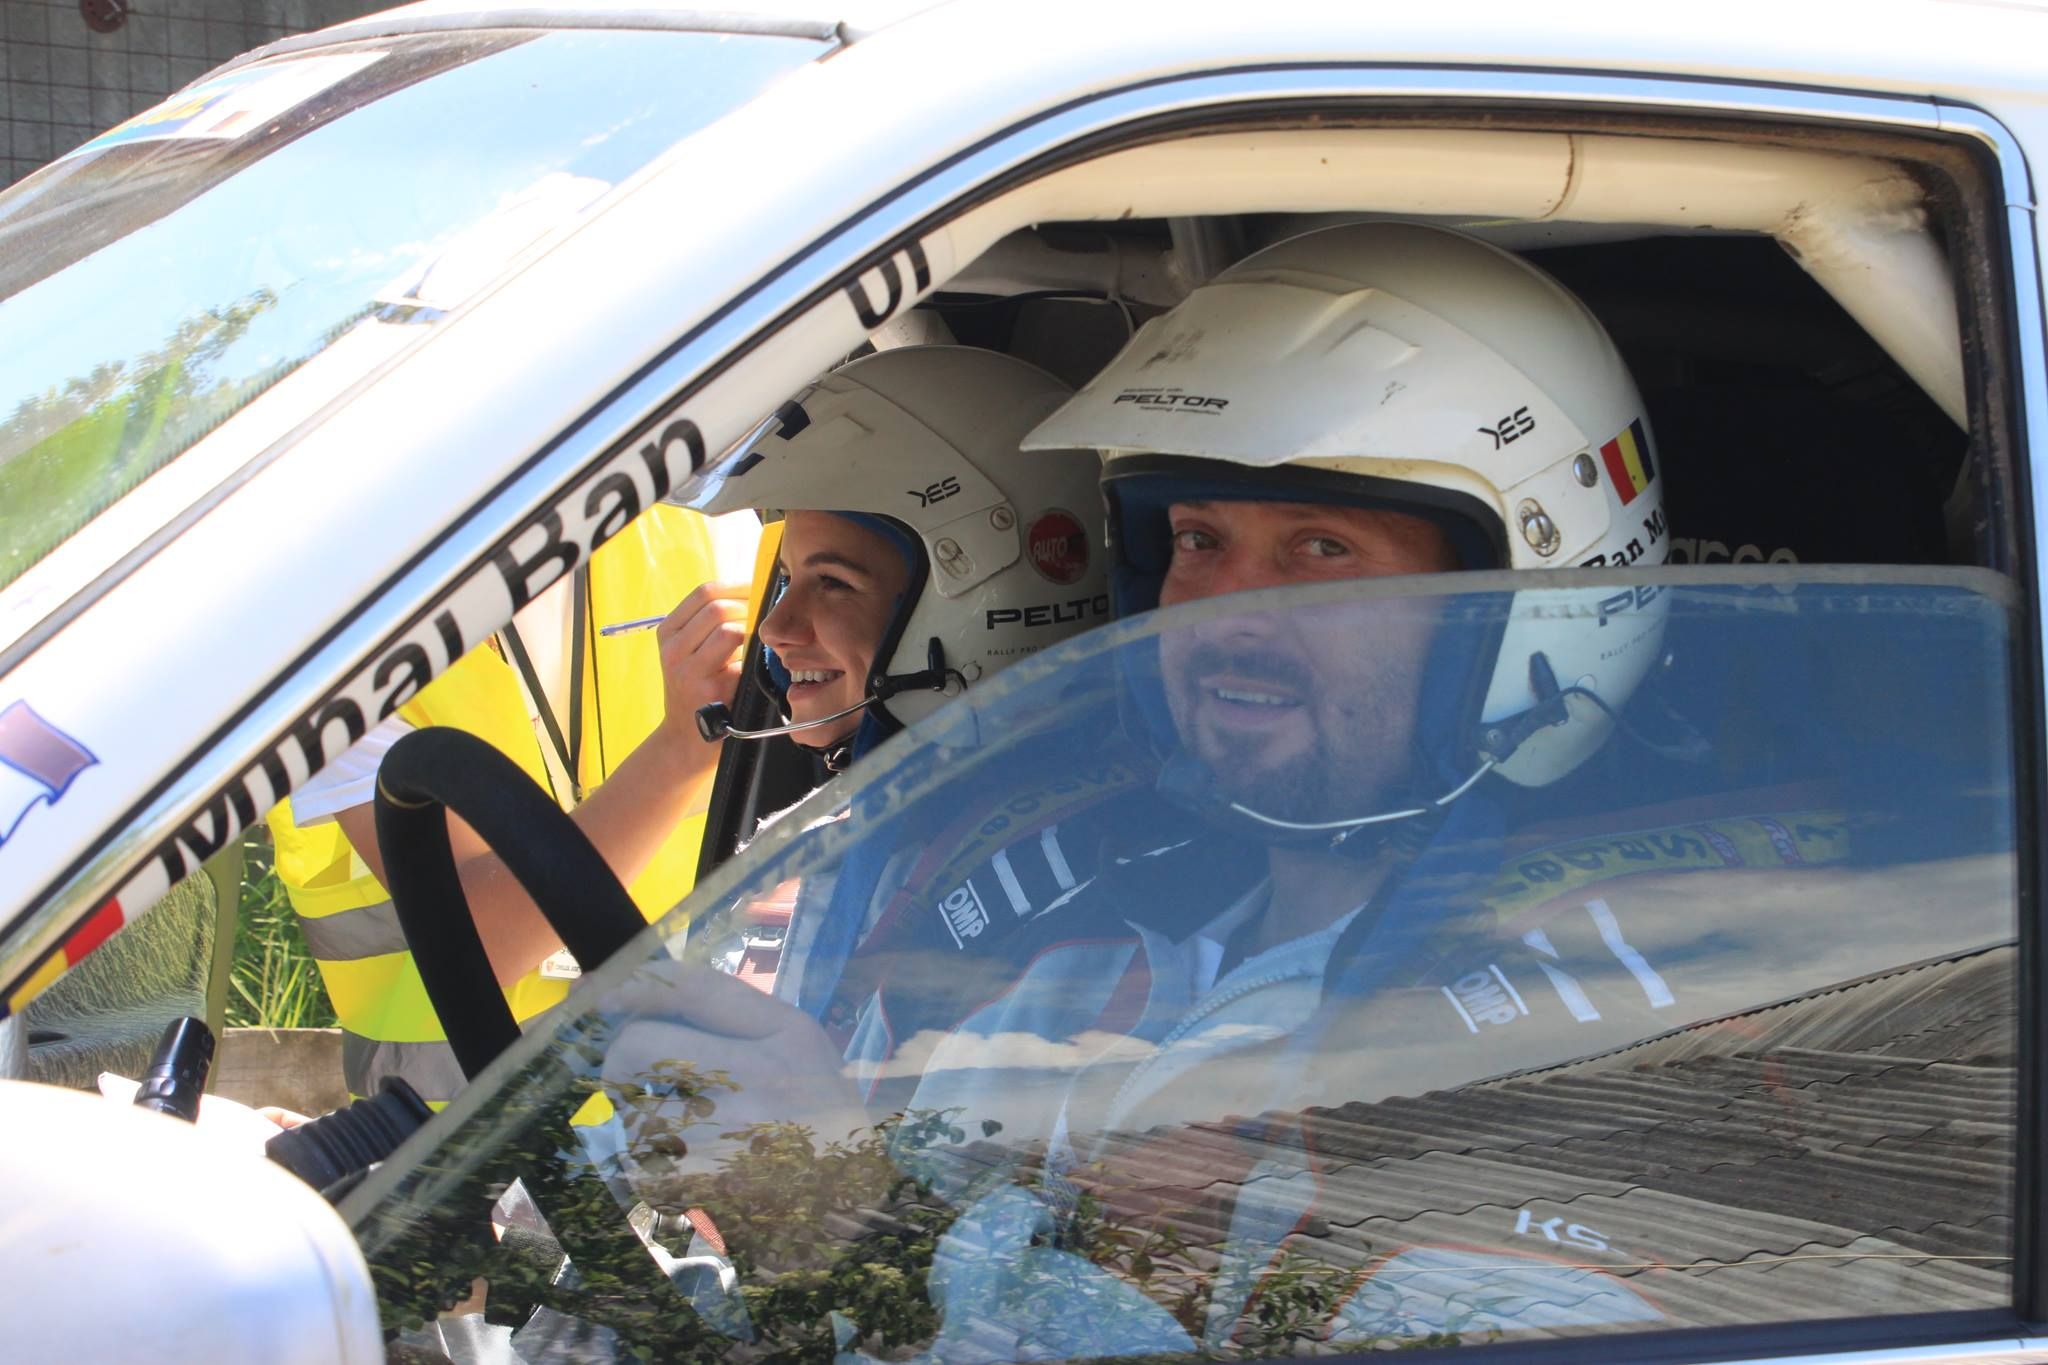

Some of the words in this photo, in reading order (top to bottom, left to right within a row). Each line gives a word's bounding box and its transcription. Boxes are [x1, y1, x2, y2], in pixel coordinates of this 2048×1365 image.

[1114, 394, 1229, 410] PELTOR
[1477, 405, 1535, 450] YES
[906, 475, 961, 508] YES
[495, 418, 706, 614] Ban
[986, 593, 1109, 631] PELTO
[943, 887, 985, 938] OMP
[1455, 970, 1517, 1025] OMP
